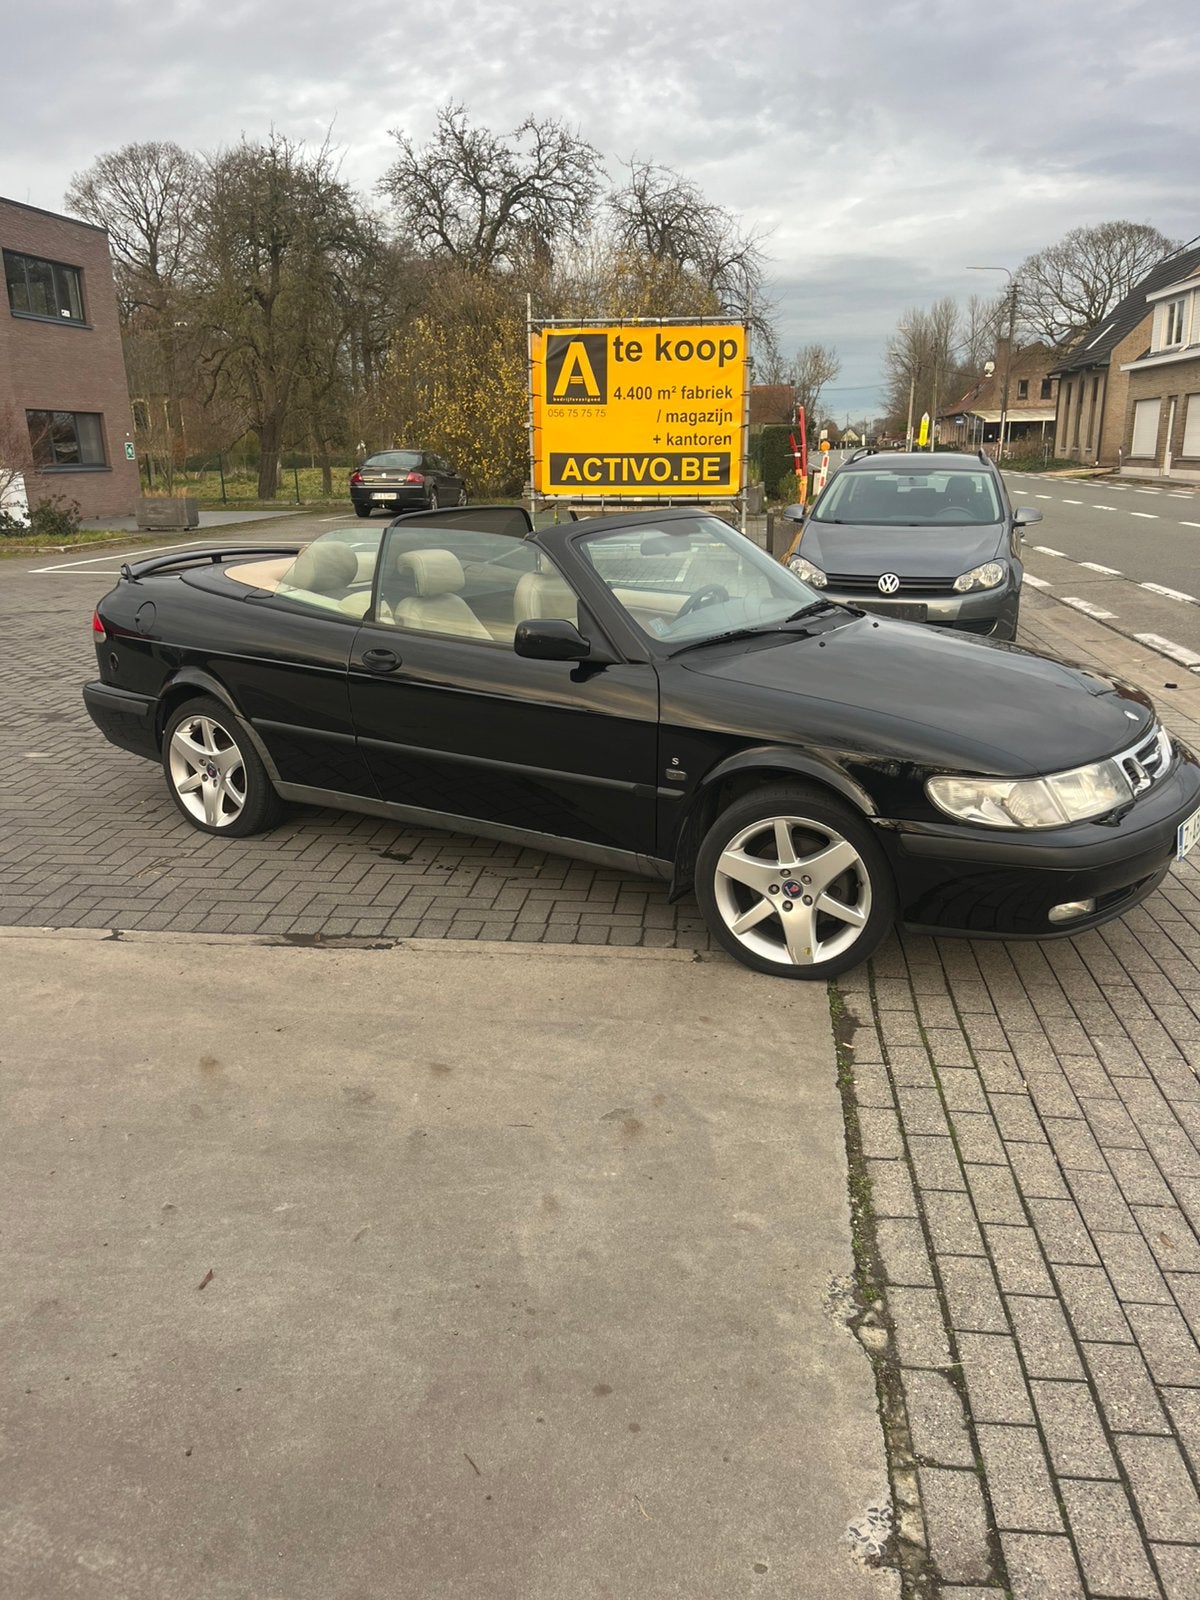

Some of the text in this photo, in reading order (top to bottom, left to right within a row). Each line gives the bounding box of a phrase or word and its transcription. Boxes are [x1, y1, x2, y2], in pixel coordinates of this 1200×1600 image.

[613, 334, 738, 367] te koop
[553, 342, 600, 396] A
[613, 386, 653, 400] 4.400
[681, 385, 733, 399] fabriek
[547, 409, 606, 417] 056 75 75 75
[665, 408, 733, 425] magazijn
[666, 432, 732, 446] kantoren
[560, 457, 721, 482] ACTIVO.BE
